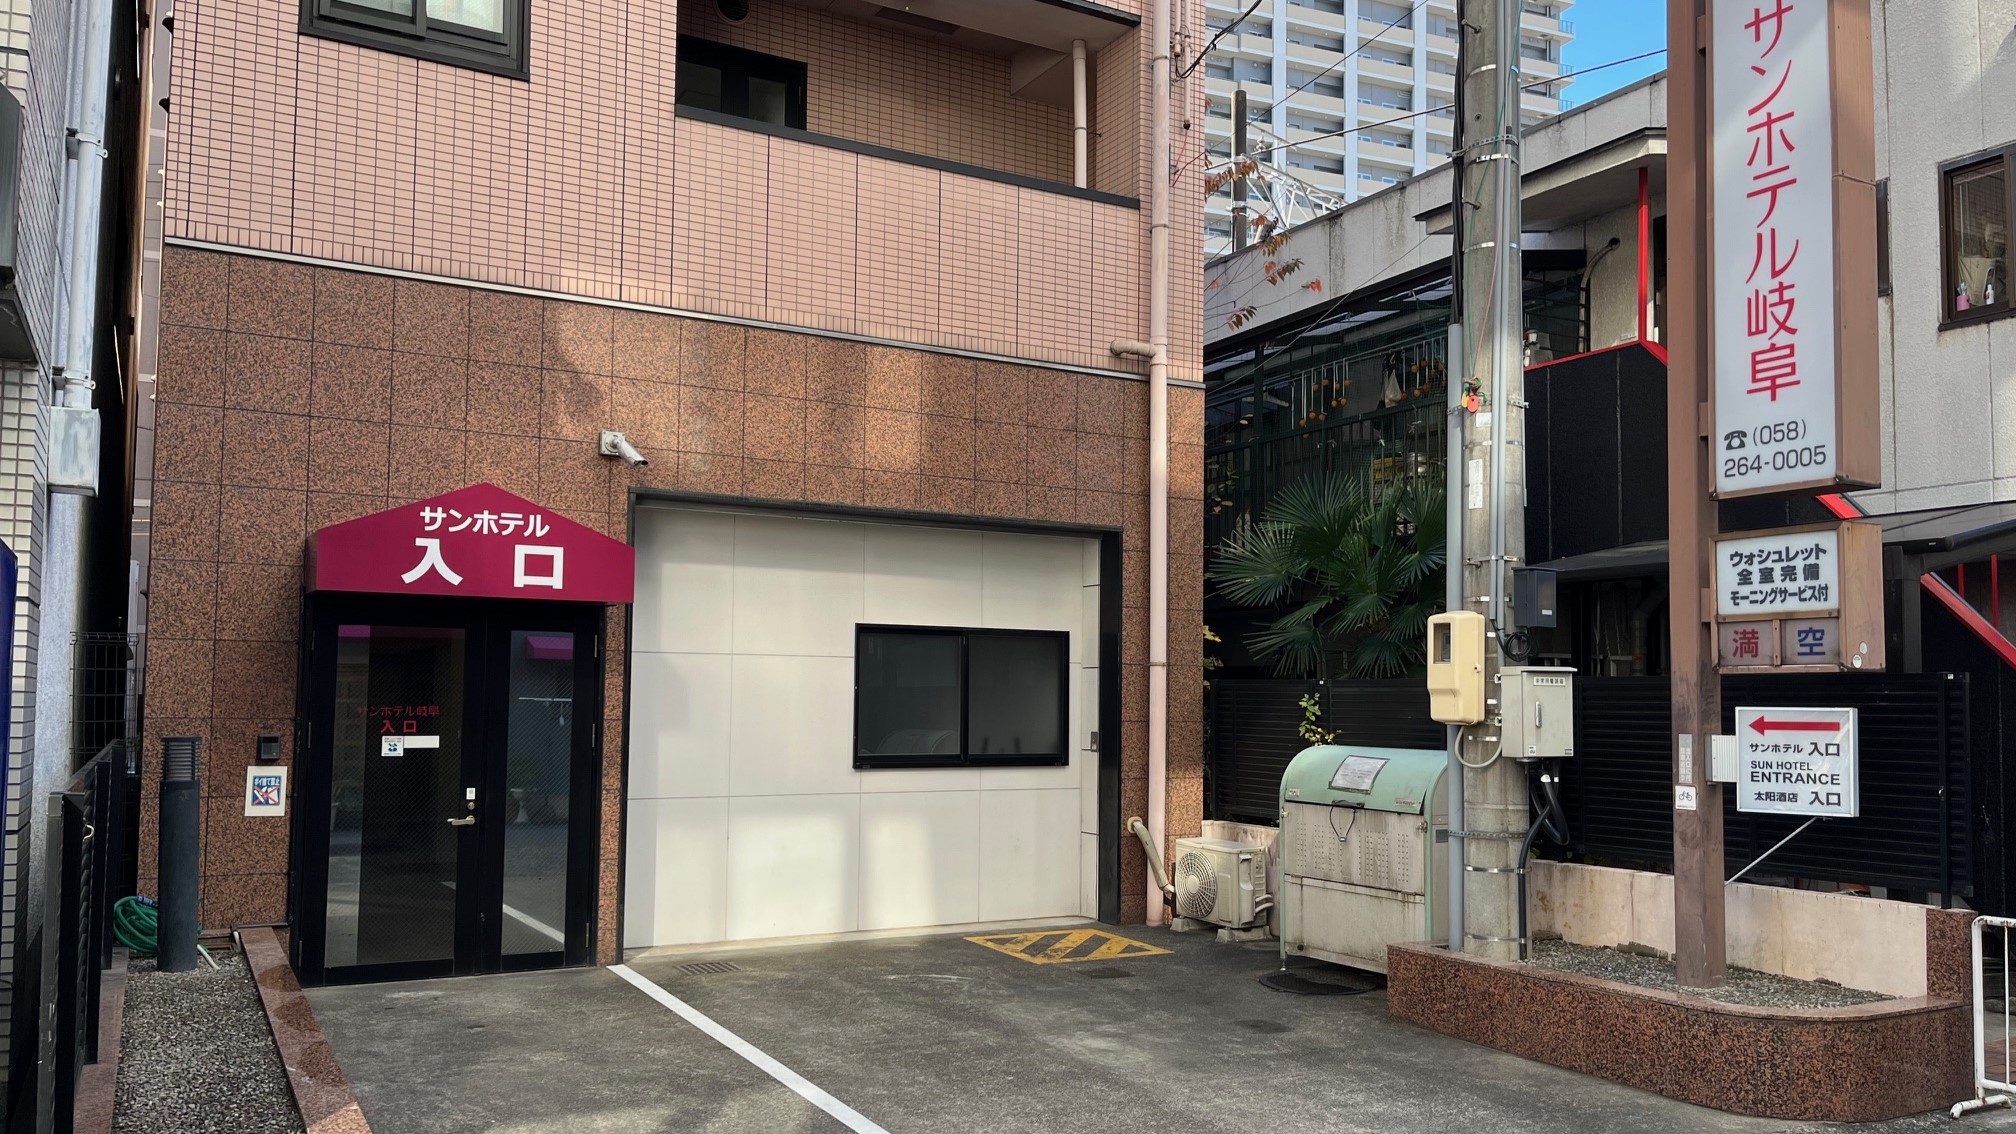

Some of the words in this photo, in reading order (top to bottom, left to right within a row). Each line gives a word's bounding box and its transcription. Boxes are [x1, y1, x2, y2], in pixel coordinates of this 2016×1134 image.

[1744, 0, 1800, 401] サンホテル岐阜
[1753, 419, 1807, 446] (058)
[1724, 445, 1827, 478] 264-0005
[420, 506, 551, 538] サンホテル
[1730, 544, 1827, 567] ウォシュレット
[1737, 563, 1820, 586] 全室完備
[1730, 584, 1829, 606] モーニングサービス付
[1732, 629, 1759, 658] 満
[1797, 627, 1826, 656] 空
[358, 705, 441, 718] サンホテル岐阜
[1749, 743, 1803, 754] サンホテル
[1808, 742, 1840, 757] 入口
[1750, 760, 1773, 770] SUN
[1776, 761, 1813, 771] HOTEL
[1750, 771, 1841, 785] ENTRANCE
[1754, 791, 1798, 802] 太阳酒店
[1809, 791, 1841, 806] 入口
